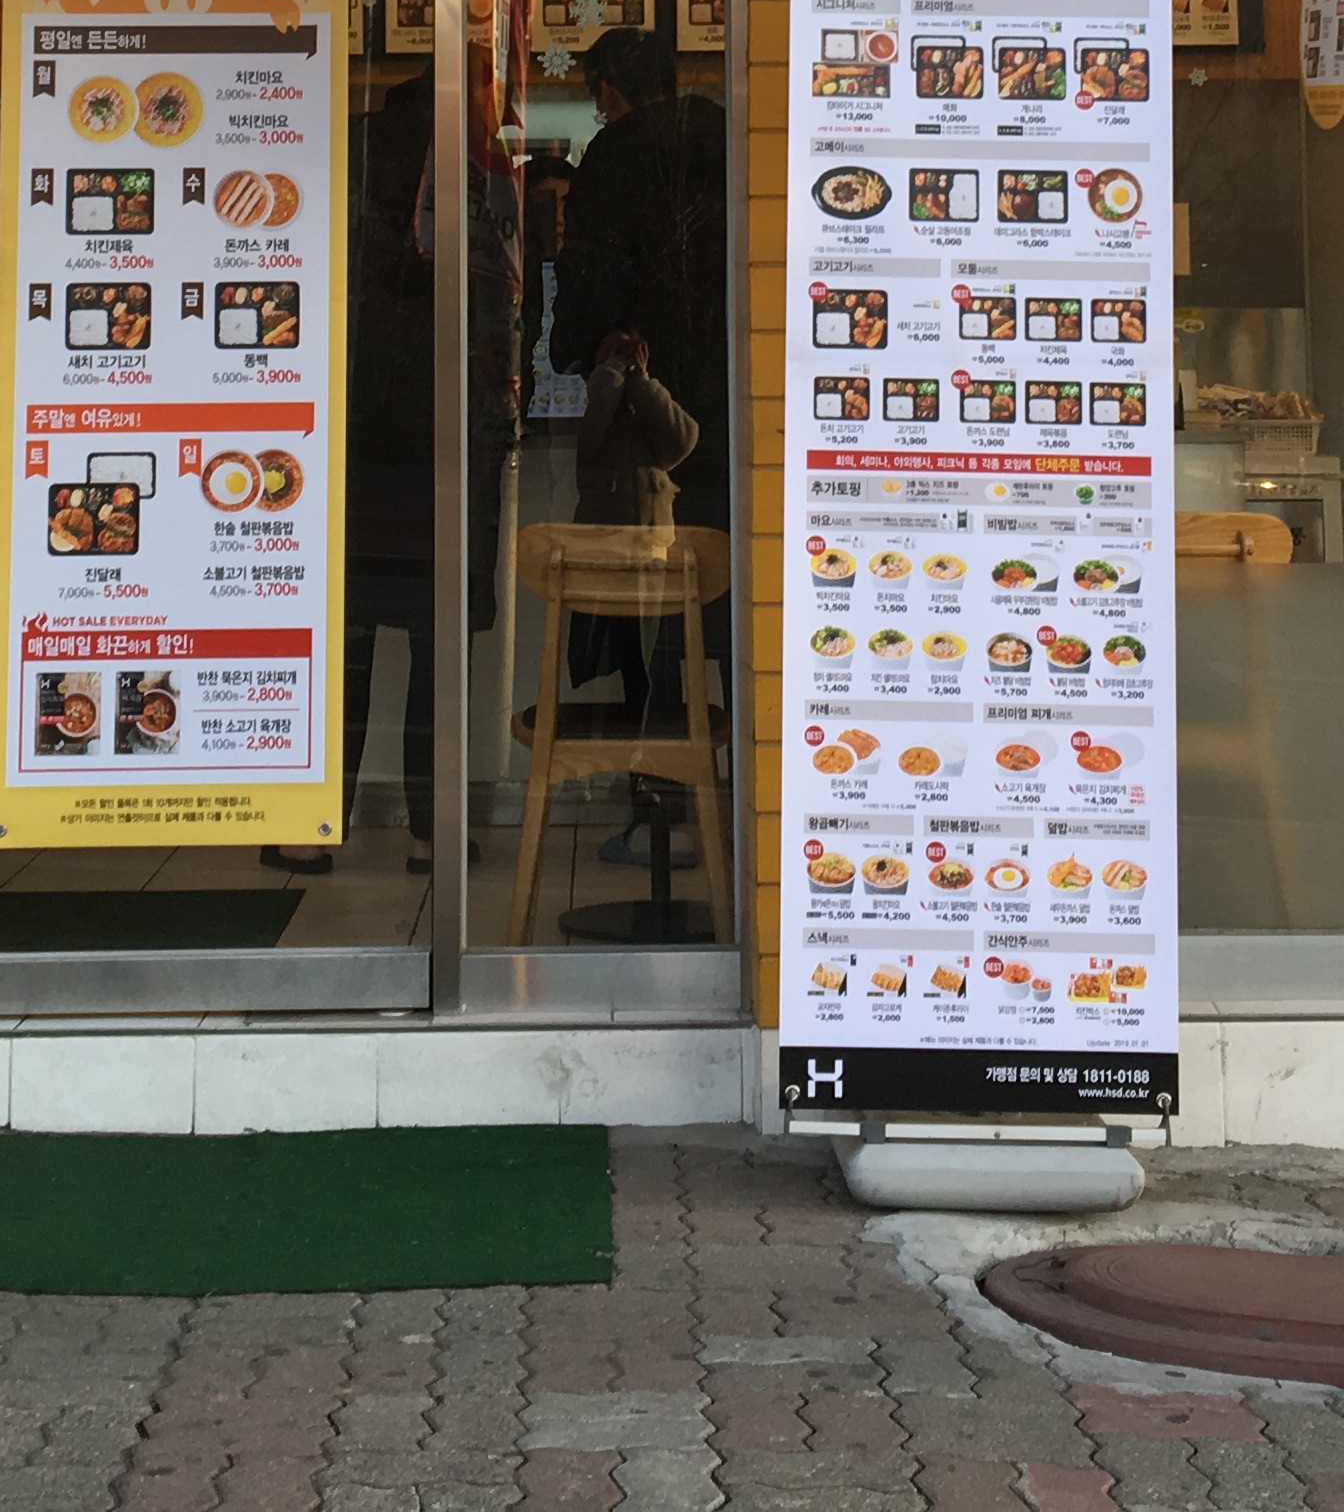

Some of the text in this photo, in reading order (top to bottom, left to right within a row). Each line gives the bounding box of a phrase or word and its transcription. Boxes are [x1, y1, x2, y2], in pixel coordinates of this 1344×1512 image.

[40, 31, 82, 50] 평일엔
[37, 65, 51, 85] 월
[235, 71, 283, 84] 치킨마요
[229, 115, 289, 129] 빅치킨마요
[34, 174, 49, 192] 화
[186, 174, 201, 192] 수
[85, 240, 133, 253] 치킨제육
[225, 240, 289, 253] 돈까스 카레
[32, 290, 47, 307] 목
[185, 289, 199, 306] 금
[97, 354, 146, 369] 고기고기
[32, 409, 75, 428] 주말엔
[30, 449, 45, 465] 토
[184, 446, 197, 464] 일
[85, 568, 121, 582] 진달래
[53, 615, 167, 627] HOT SALE EVERYDAY
[28, 636, 91, 656] 매일매일
[97, 635, 151, 655] 화끈하게
[257, 670, 297, 685] 김치찌개
[225, 719, 256, 733] 소고기
[986, 1067, 1149, 1084] 가맹점 문의 및 상담 1811-0188
[1078, 1088, 1149, 1098] www.hsd.co.kr
